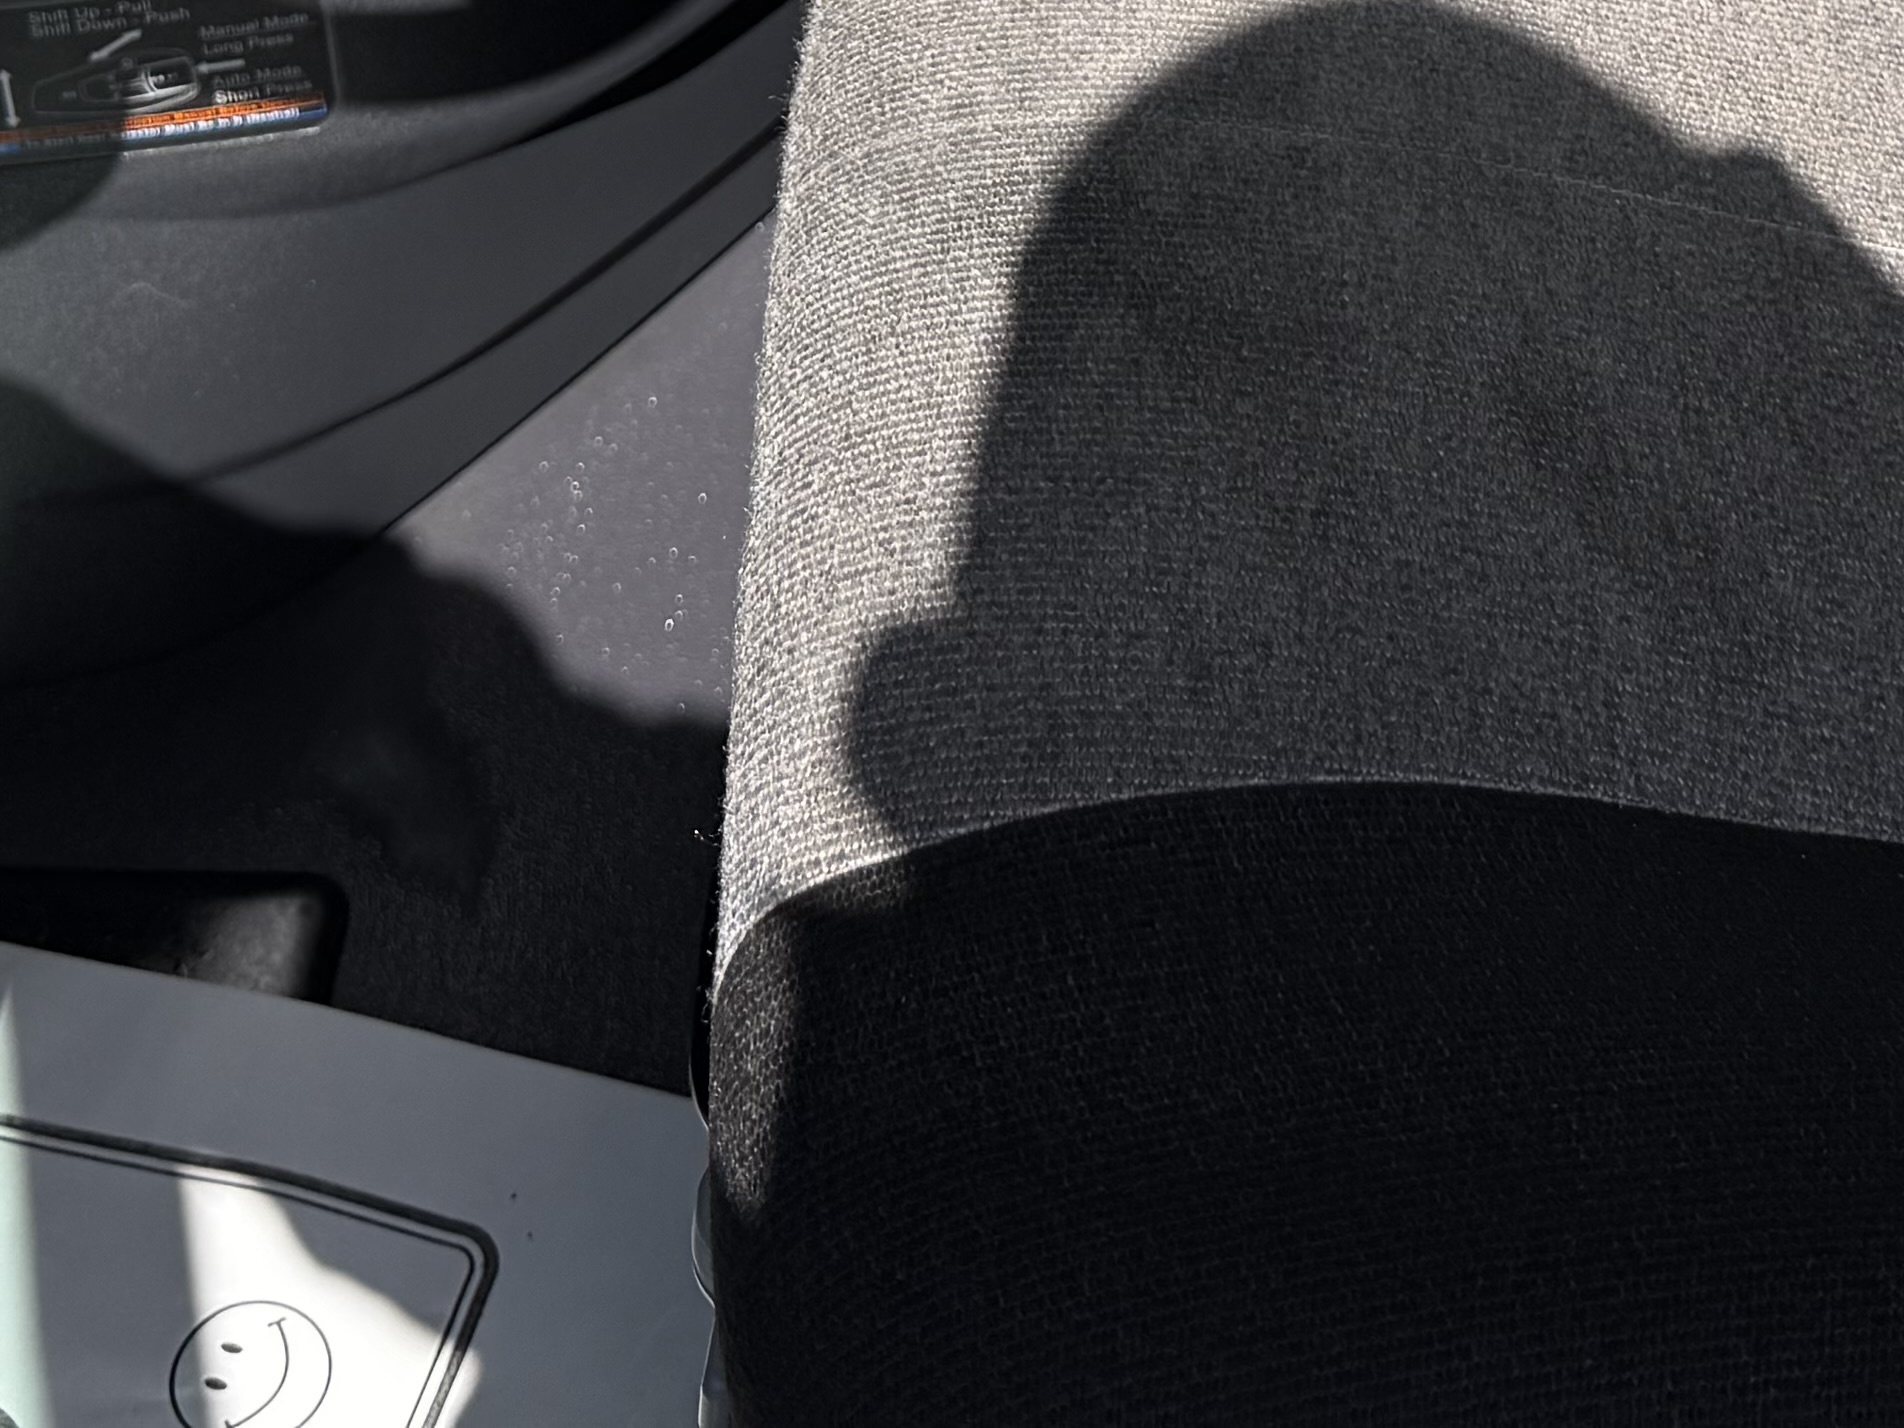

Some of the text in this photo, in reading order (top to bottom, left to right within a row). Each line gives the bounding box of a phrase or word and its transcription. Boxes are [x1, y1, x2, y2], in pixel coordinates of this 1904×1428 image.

[28, 9, 69, 24] Shift
[74, 7, 100, 21] Up
[115, 0, 152, 14] Pull
[31, 23, 72, 37] Shift
[77, 17, 128, 34] Down
[143, 7, 190, 24] Push
[200, 12, 310, 40] Manual Mode
[203, 32, 294, 55] Long Press
[212, 64, 302, 88] Auto Mode
[213, 89, 260, 104] Short
